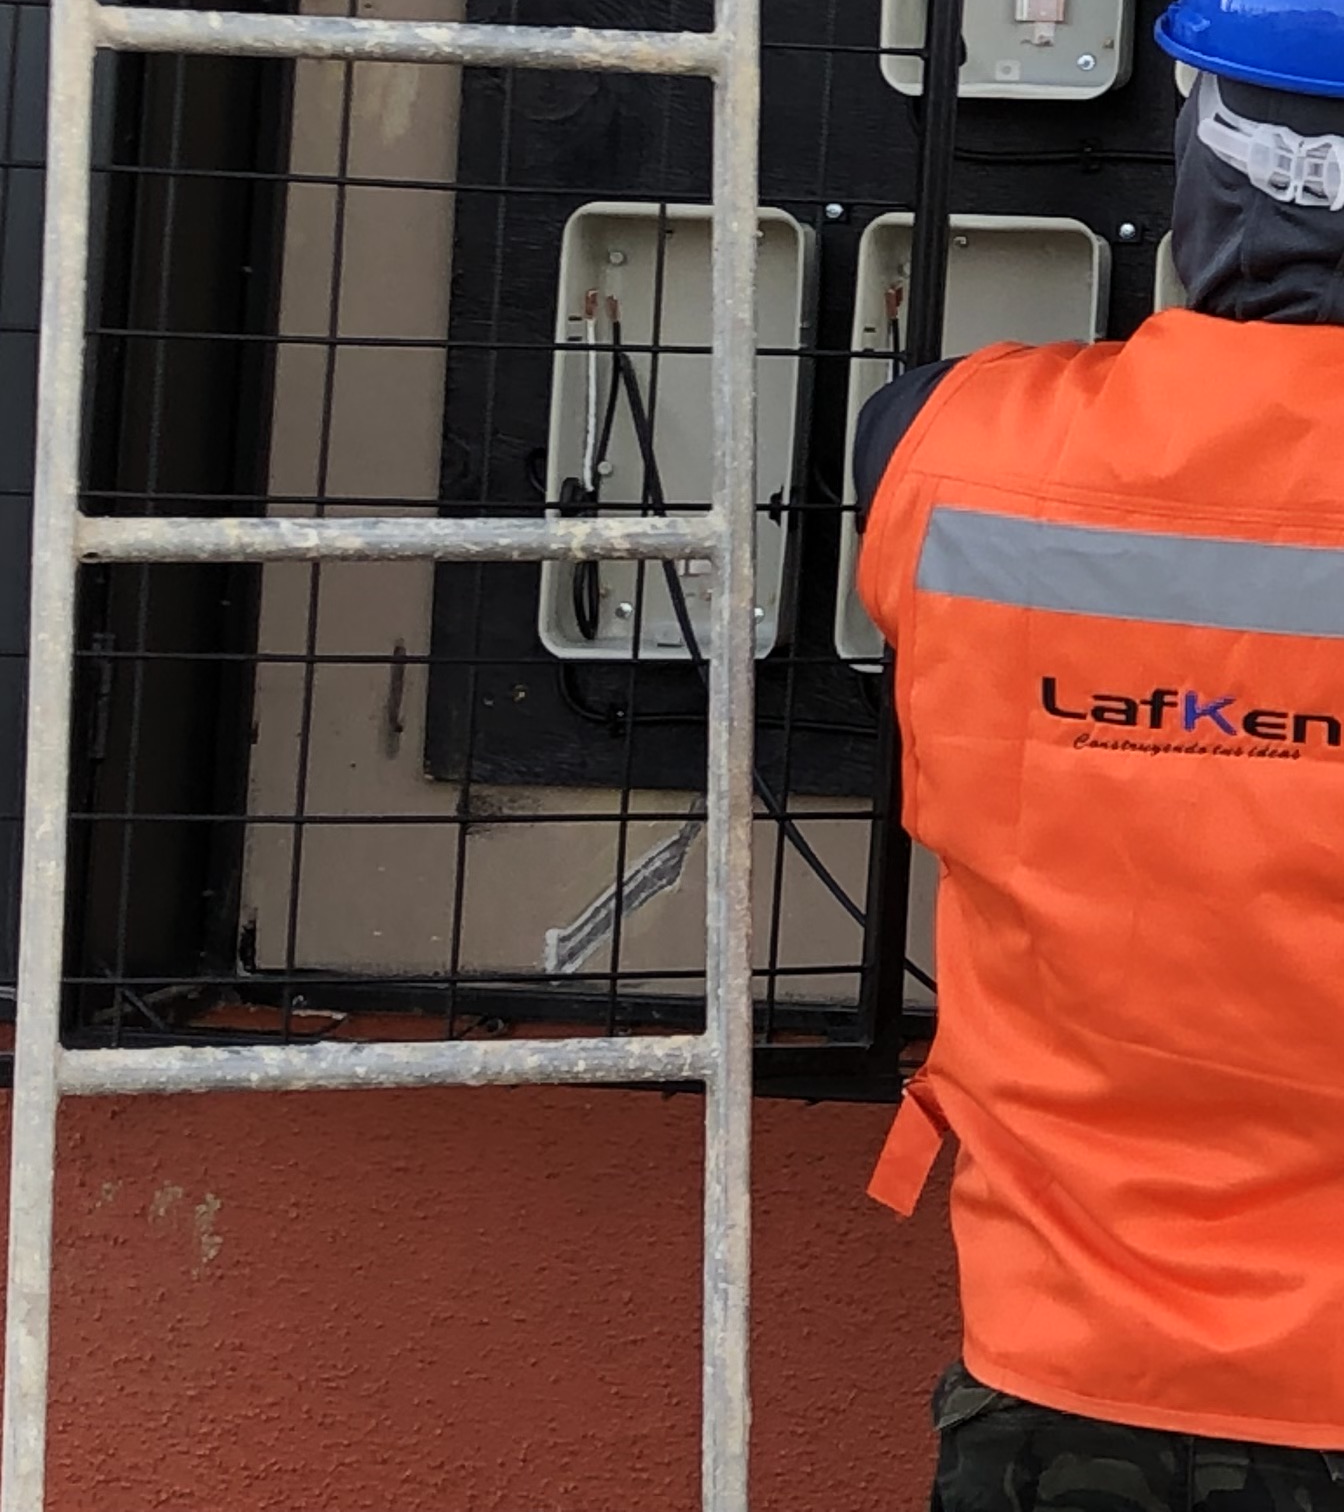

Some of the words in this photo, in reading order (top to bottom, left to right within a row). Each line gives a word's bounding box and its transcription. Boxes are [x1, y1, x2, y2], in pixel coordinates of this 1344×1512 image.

[1041, 676, 1342, 747] LafKen
[1073, 733, 1207, 756] Construyendo
[1212, 744, 1243, 757] tus
[1247, 744, 1300, 760] ideas
